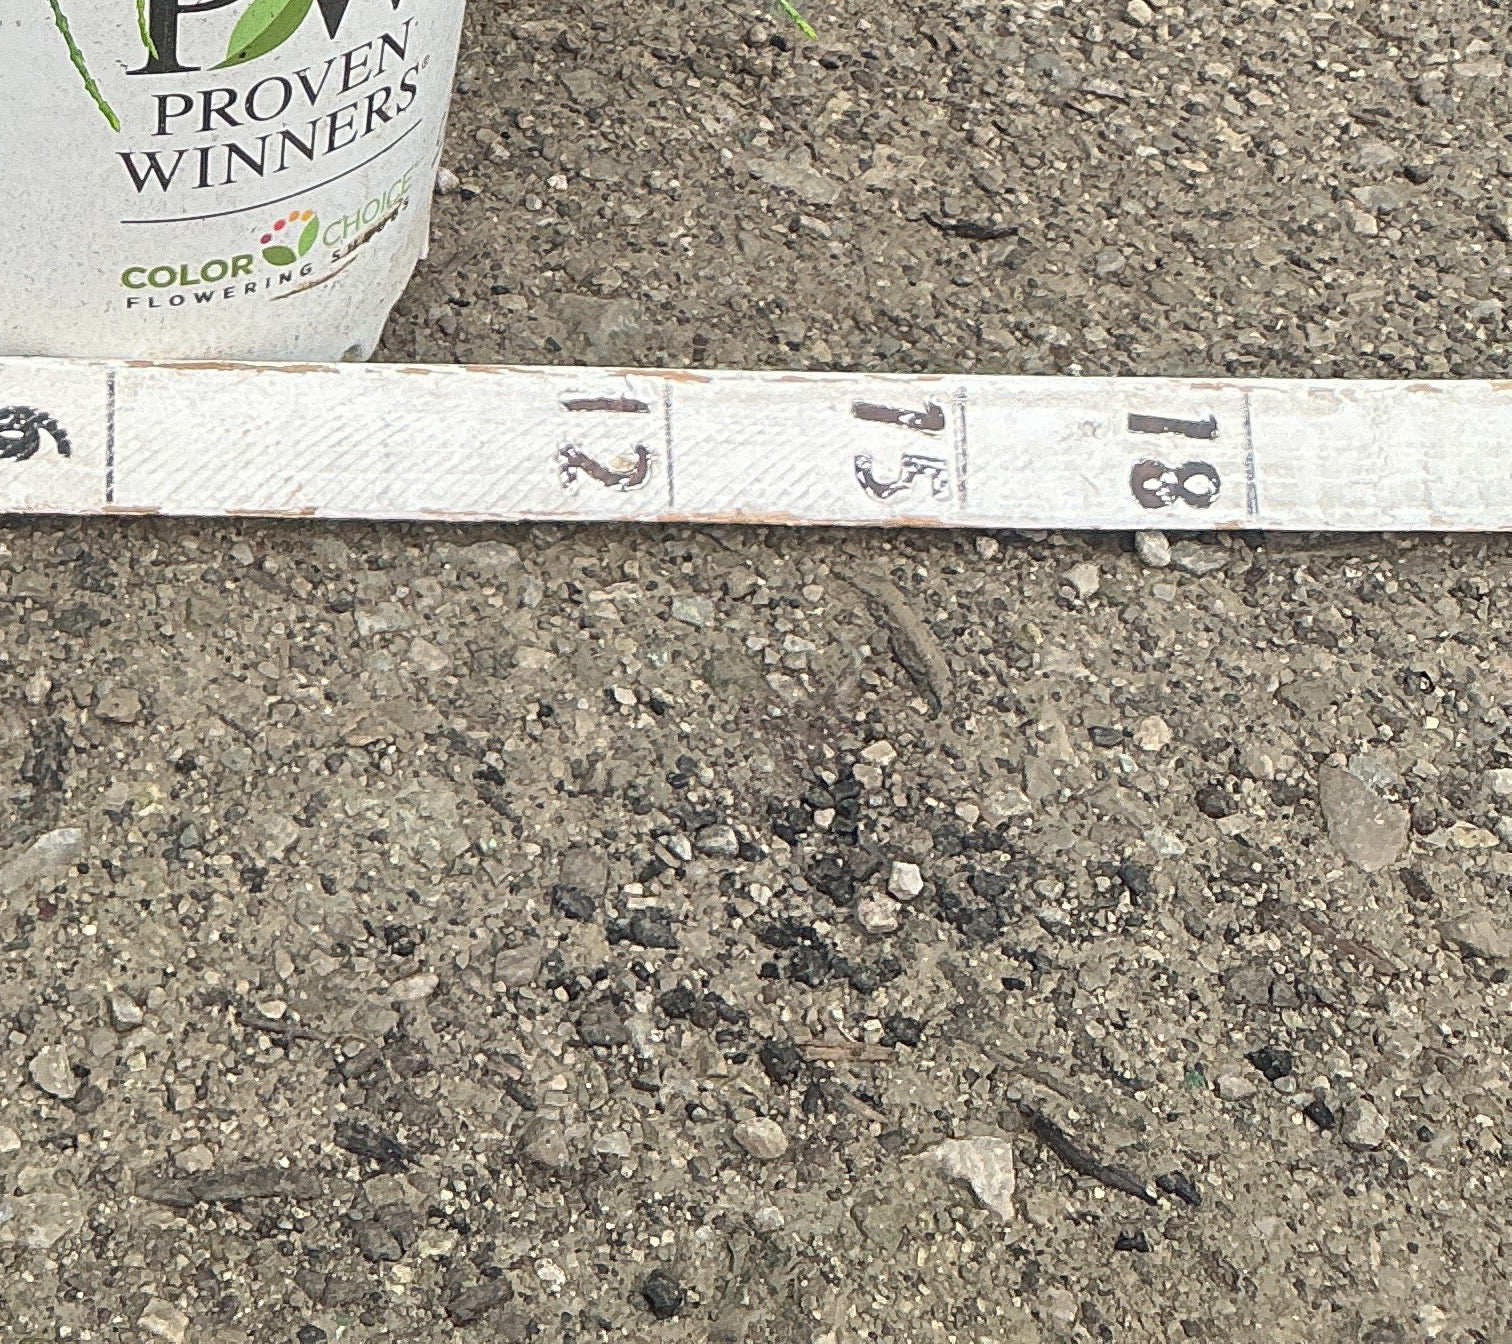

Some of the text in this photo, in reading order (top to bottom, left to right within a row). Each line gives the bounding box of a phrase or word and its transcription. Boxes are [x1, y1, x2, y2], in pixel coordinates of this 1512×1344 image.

[151, 16, 414, 136] PROVEN
[121, 168, 413, 289] COLOR CHOICE
[127, 262, 312, 308] FLOWERING
[559, 395, 652, 494] 12
[850, 398, 948, 499] 15
[1128, 411, 1221, 509] 18
